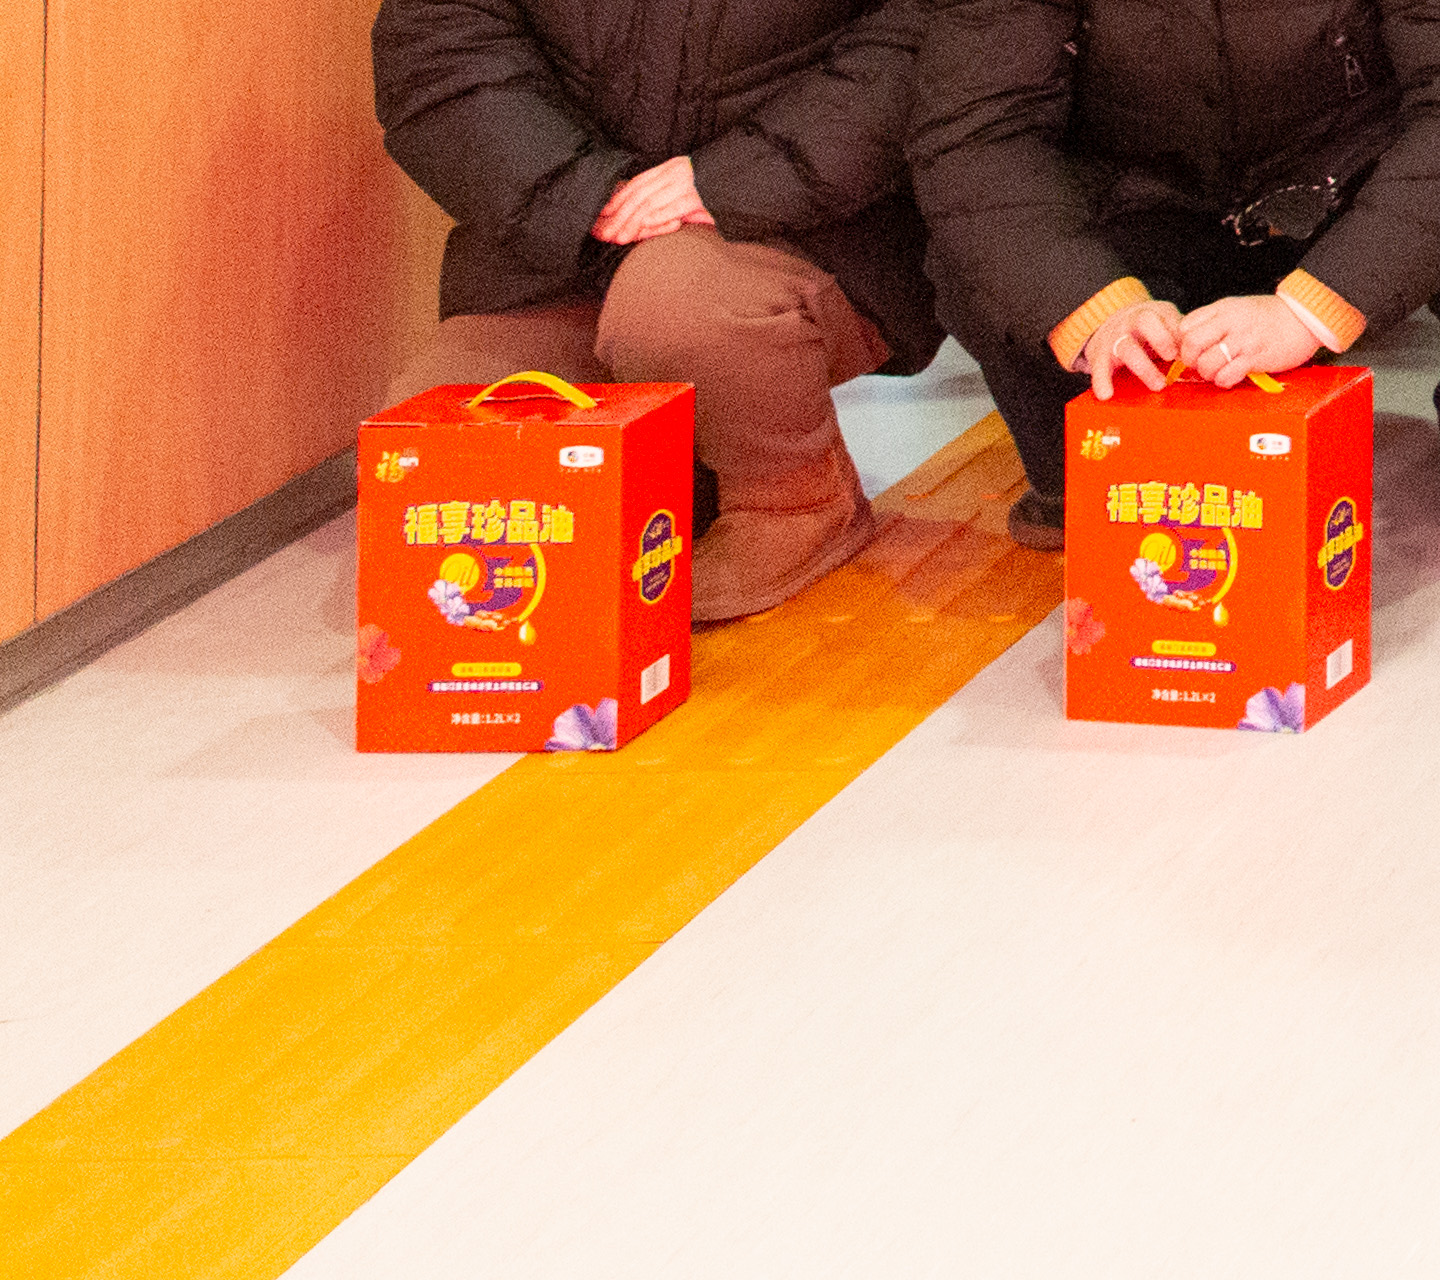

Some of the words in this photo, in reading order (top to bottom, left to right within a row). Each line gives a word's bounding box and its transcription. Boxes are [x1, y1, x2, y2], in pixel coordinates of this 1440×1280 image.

[404, 499, 575, 544] 福享珍品油
[1106, 481, 1264, 529] 福享珍品油
